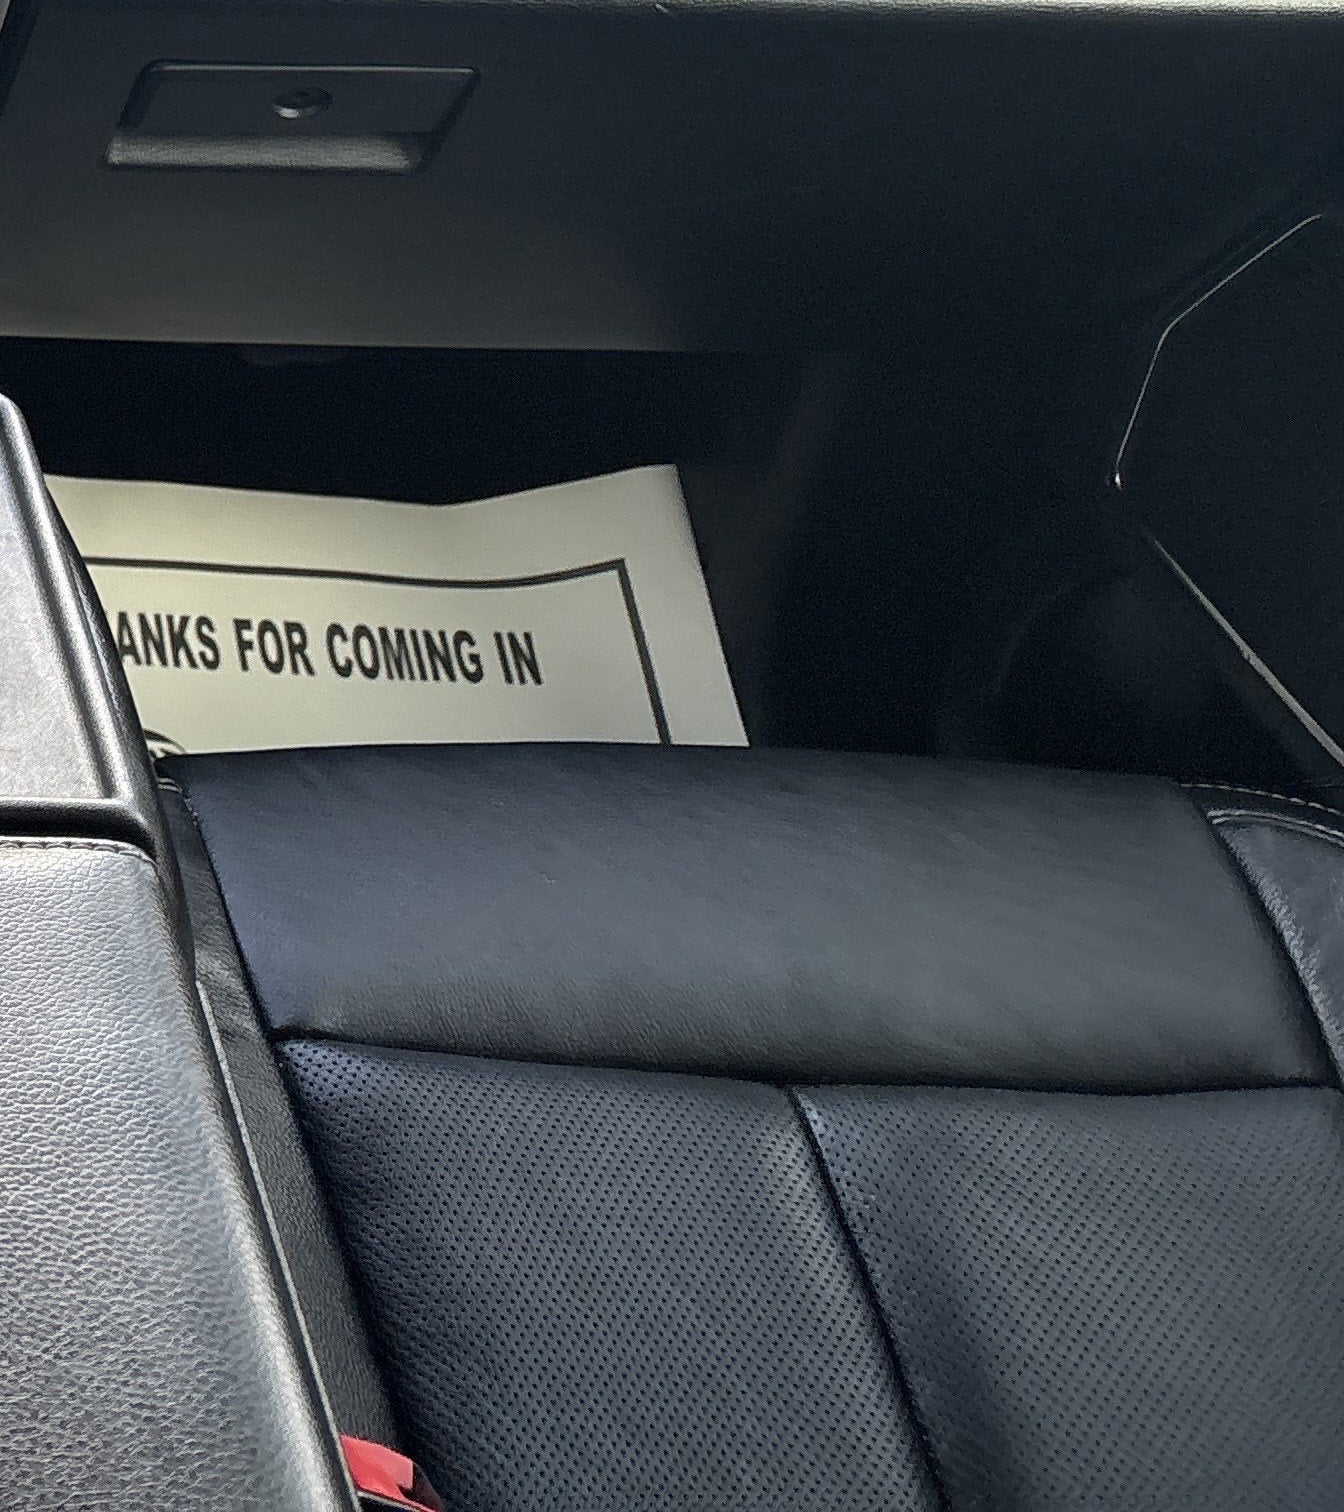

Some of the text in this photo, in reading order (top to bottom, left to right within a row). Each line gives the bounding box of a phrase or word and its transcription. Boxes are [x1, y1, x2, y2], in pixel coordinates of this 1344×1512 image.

[112, 610, 544, 687] ANKS FOR COMING IN
